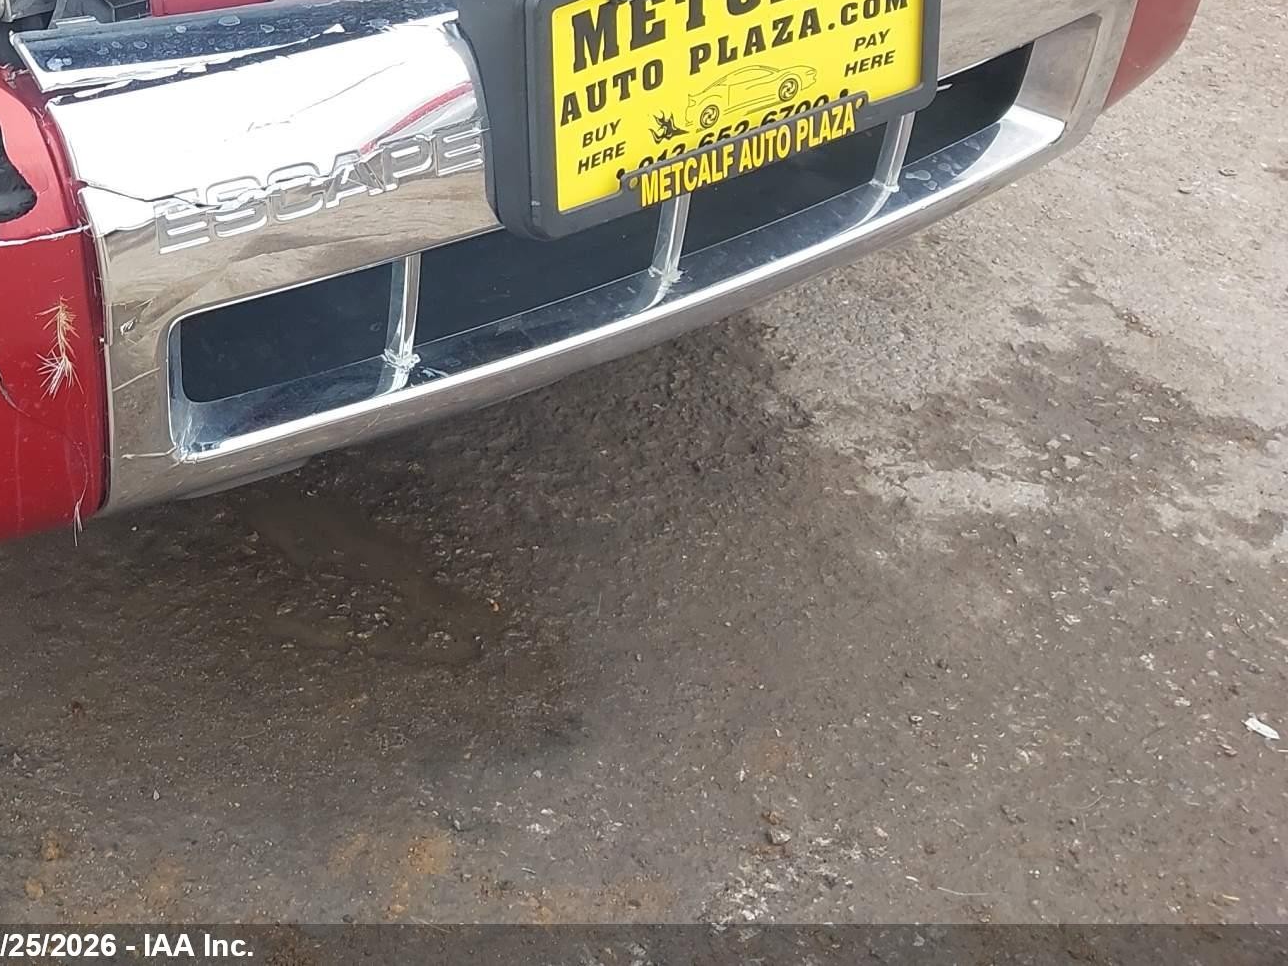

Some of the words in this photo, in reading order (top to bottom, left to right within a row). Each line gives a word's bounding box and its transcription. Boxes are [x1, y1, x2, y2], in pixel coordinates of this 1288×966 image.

[853, 28, 891, 52] PAY
[844, 50, 897, 78] HERE
[560, 58, 664, 127] AUTO
[582, 118, 623, 149] BUY
[577, 140, 627, 176] HERE
[641, 143, 734, 208] METCALF
[738, 125, 792, 174] AUTO
[796, 102, 856, 153] PLAZA
[153, 118, 487, 254] ESCAPE
